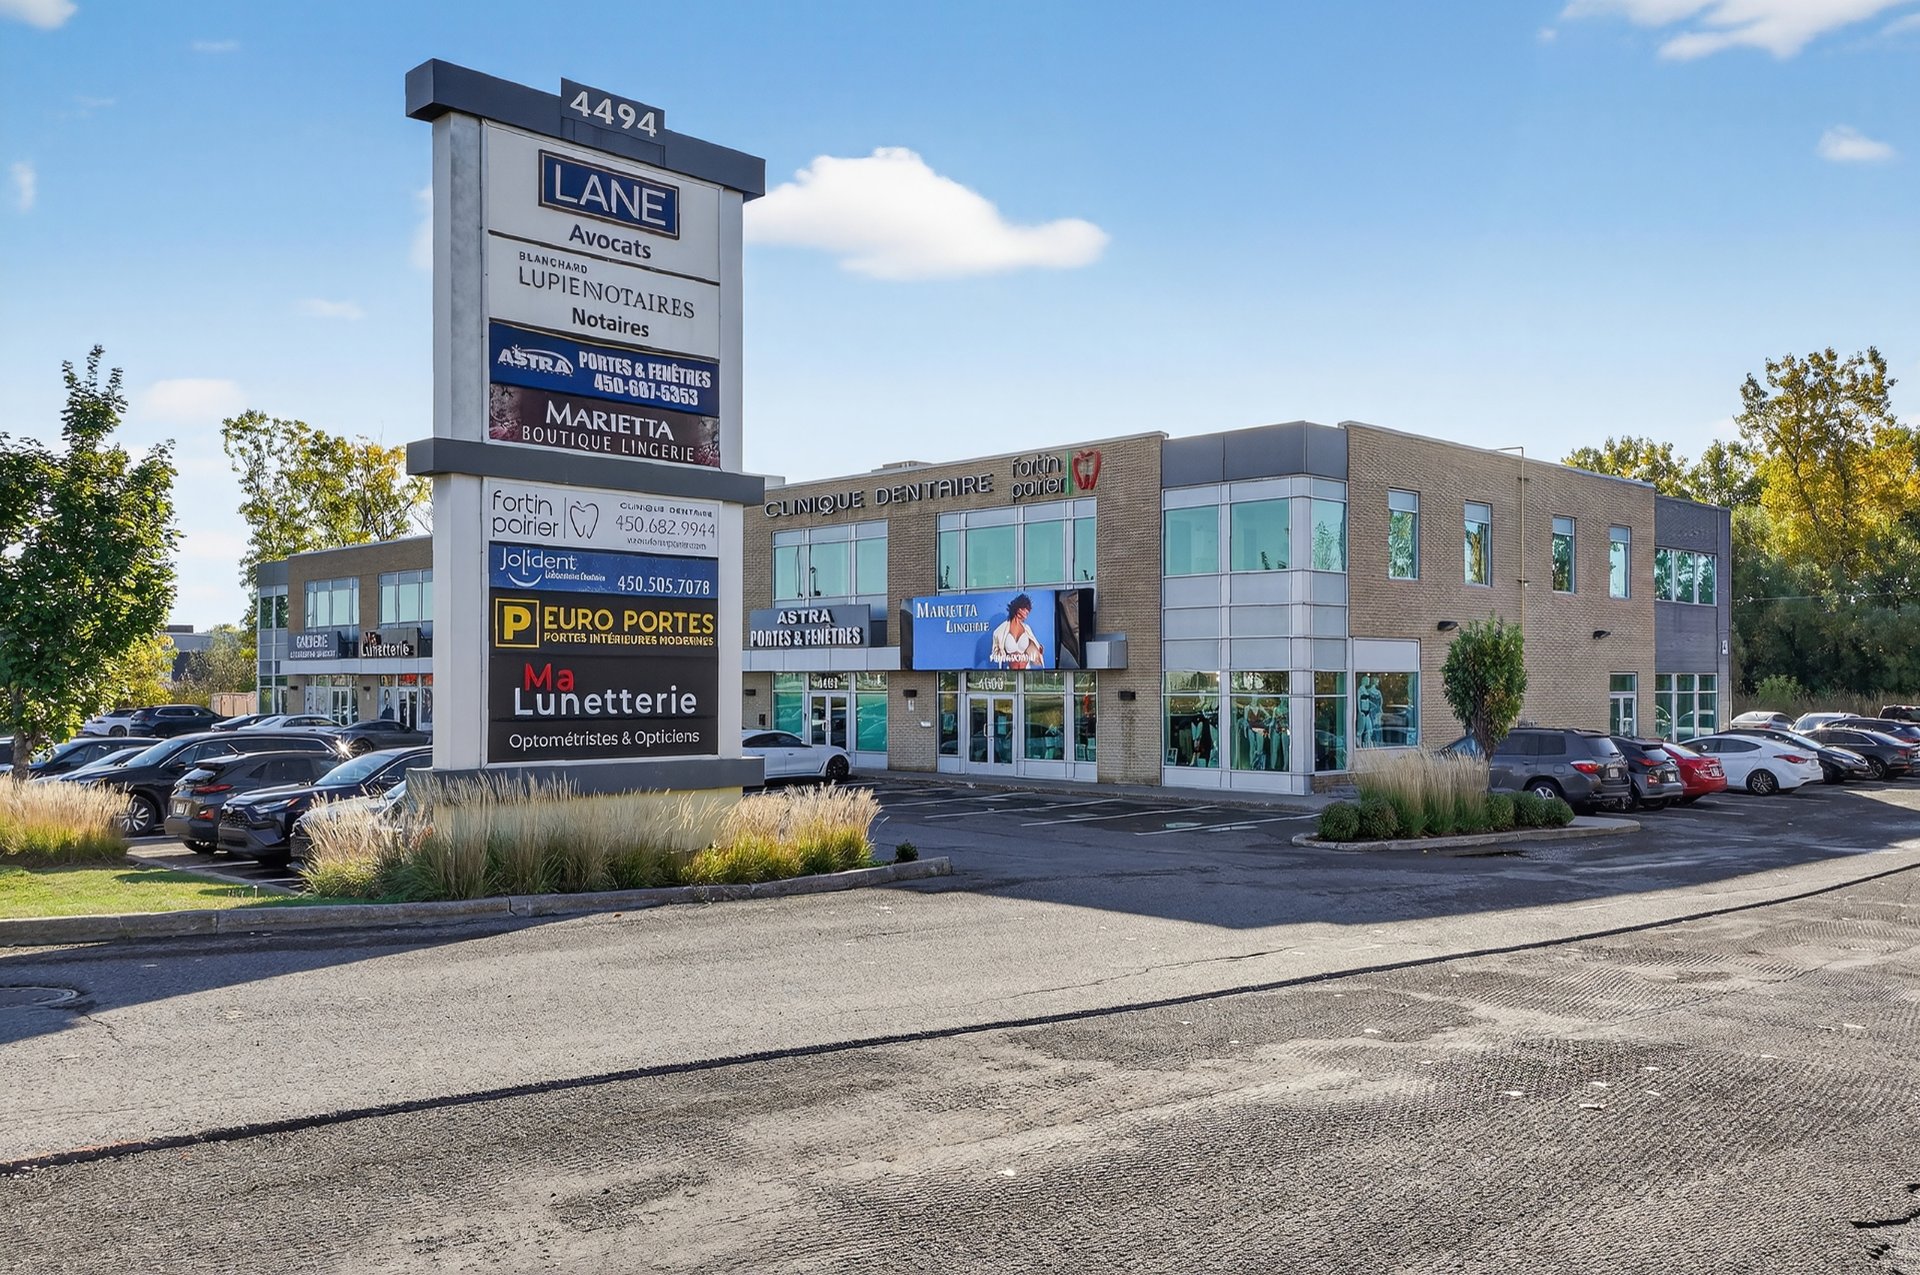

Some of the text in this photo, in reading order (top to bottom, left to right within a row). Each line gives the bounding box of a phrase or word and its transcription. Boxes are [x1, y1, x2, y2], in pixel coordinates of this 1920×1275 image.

[569, 90, 657, 137] 4494
[555, 163, 666, 226] LANE
[569, 224, 652, 259] Avocats
[519, 251, 588, 274] BLANCHARD
[572, 307, 649, 338] Notaires
[497, 346, 573, 376] ASTRA
[578, 351, 712, 389] PORTES & FENÊTRES
[545, 400, 674, 442] MARIETTA
[522, 426, 695, 462] BOUTIQUE LINGERIE
[1011, 454, 1062, 478] fortin
[492, 489, 553, 517] fortin
[763, 473, 994, 518] CLINIQUE DENTAIRE
[1011, 478, 1066, 504] poirier
[492, 514, 559, 538] poirier
[615, 514, 716, 539] 450.682.9944
[500, 546, 578, 577] Jolident
[617, 575, 711, 596] 450.505.7078
[503, 605, 532, 641] P
[543, 606, 715, 635] EURO PORTES
[776, 608, 833, 625] ASTRA
[543, 631, 587, 644] PORTES
[659, 635, 715, 647] MODERNES
[750, 629, 792, 648] PORTES
[794, 630, 804, 647] &
[524, 663, 576, 692] Ma
[514, 685, 697, 716] Lunetterie
[509, 729, 700, 752] Optométristes & Opticiens
